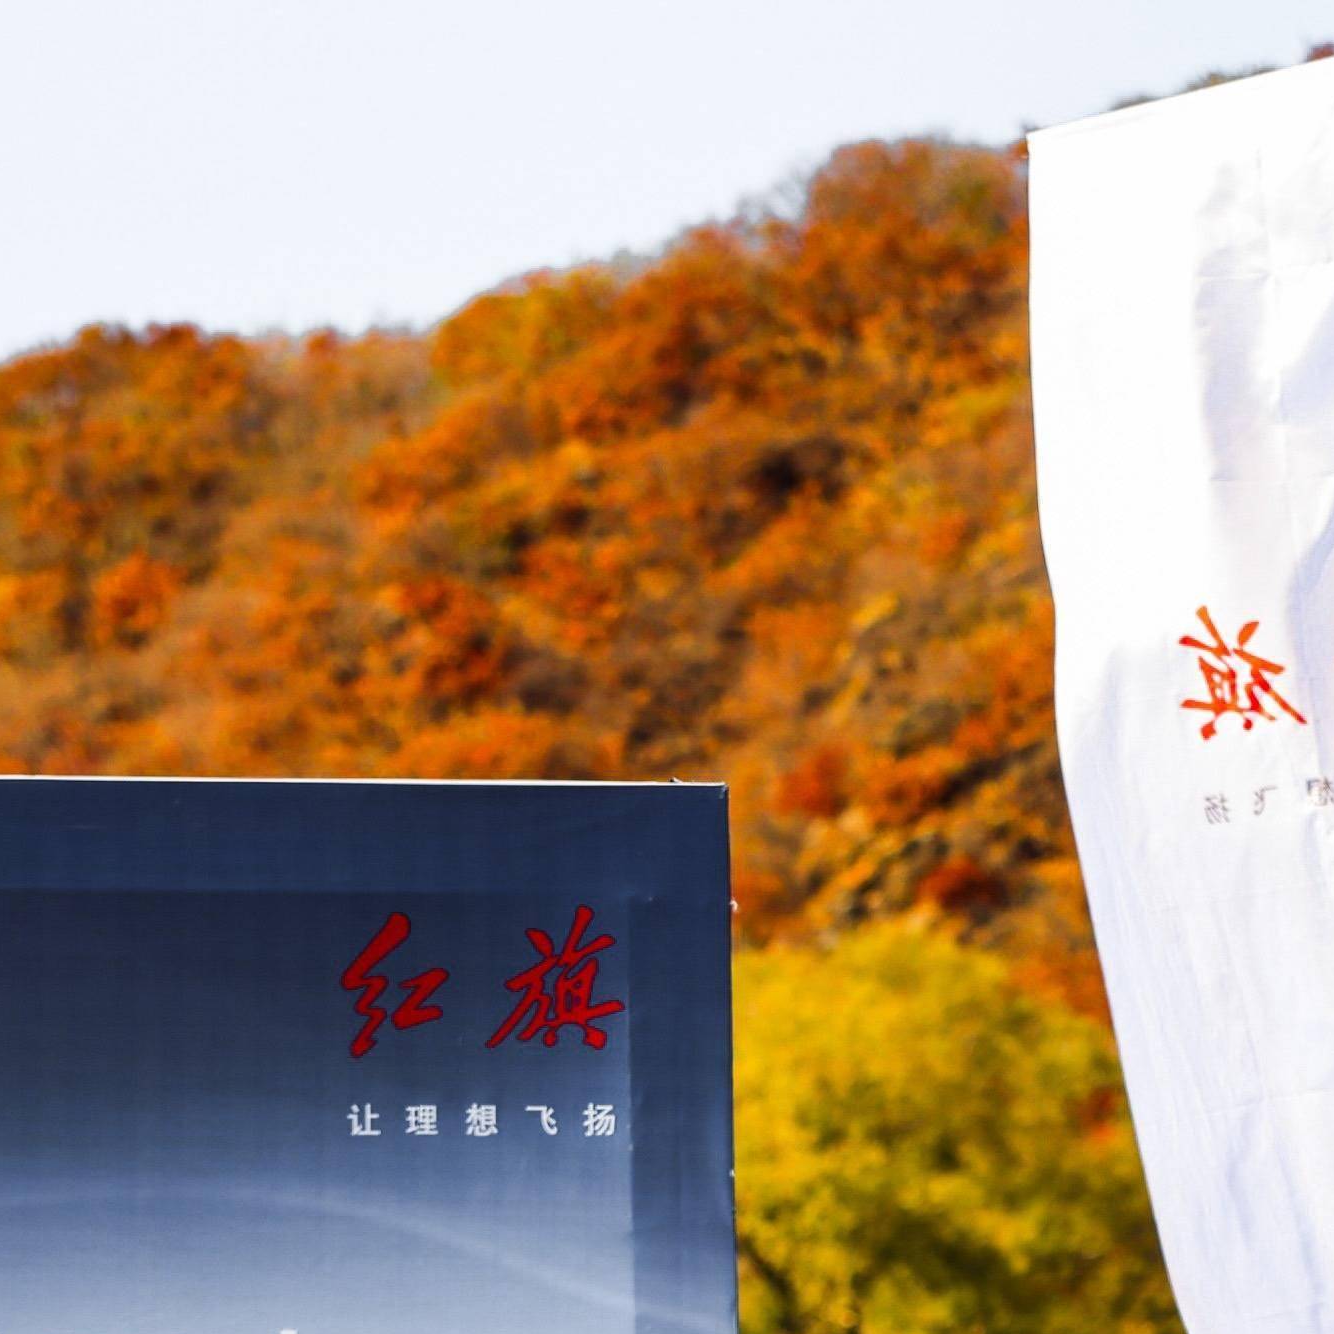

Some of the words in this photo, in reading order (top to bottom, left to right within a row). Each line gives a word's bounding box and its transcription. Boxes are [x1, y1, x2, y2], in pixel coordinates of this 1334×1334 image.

[341, 904, 625, 1058] 红旗
[346, 1102, 617, 1137] 让理想飞扬
